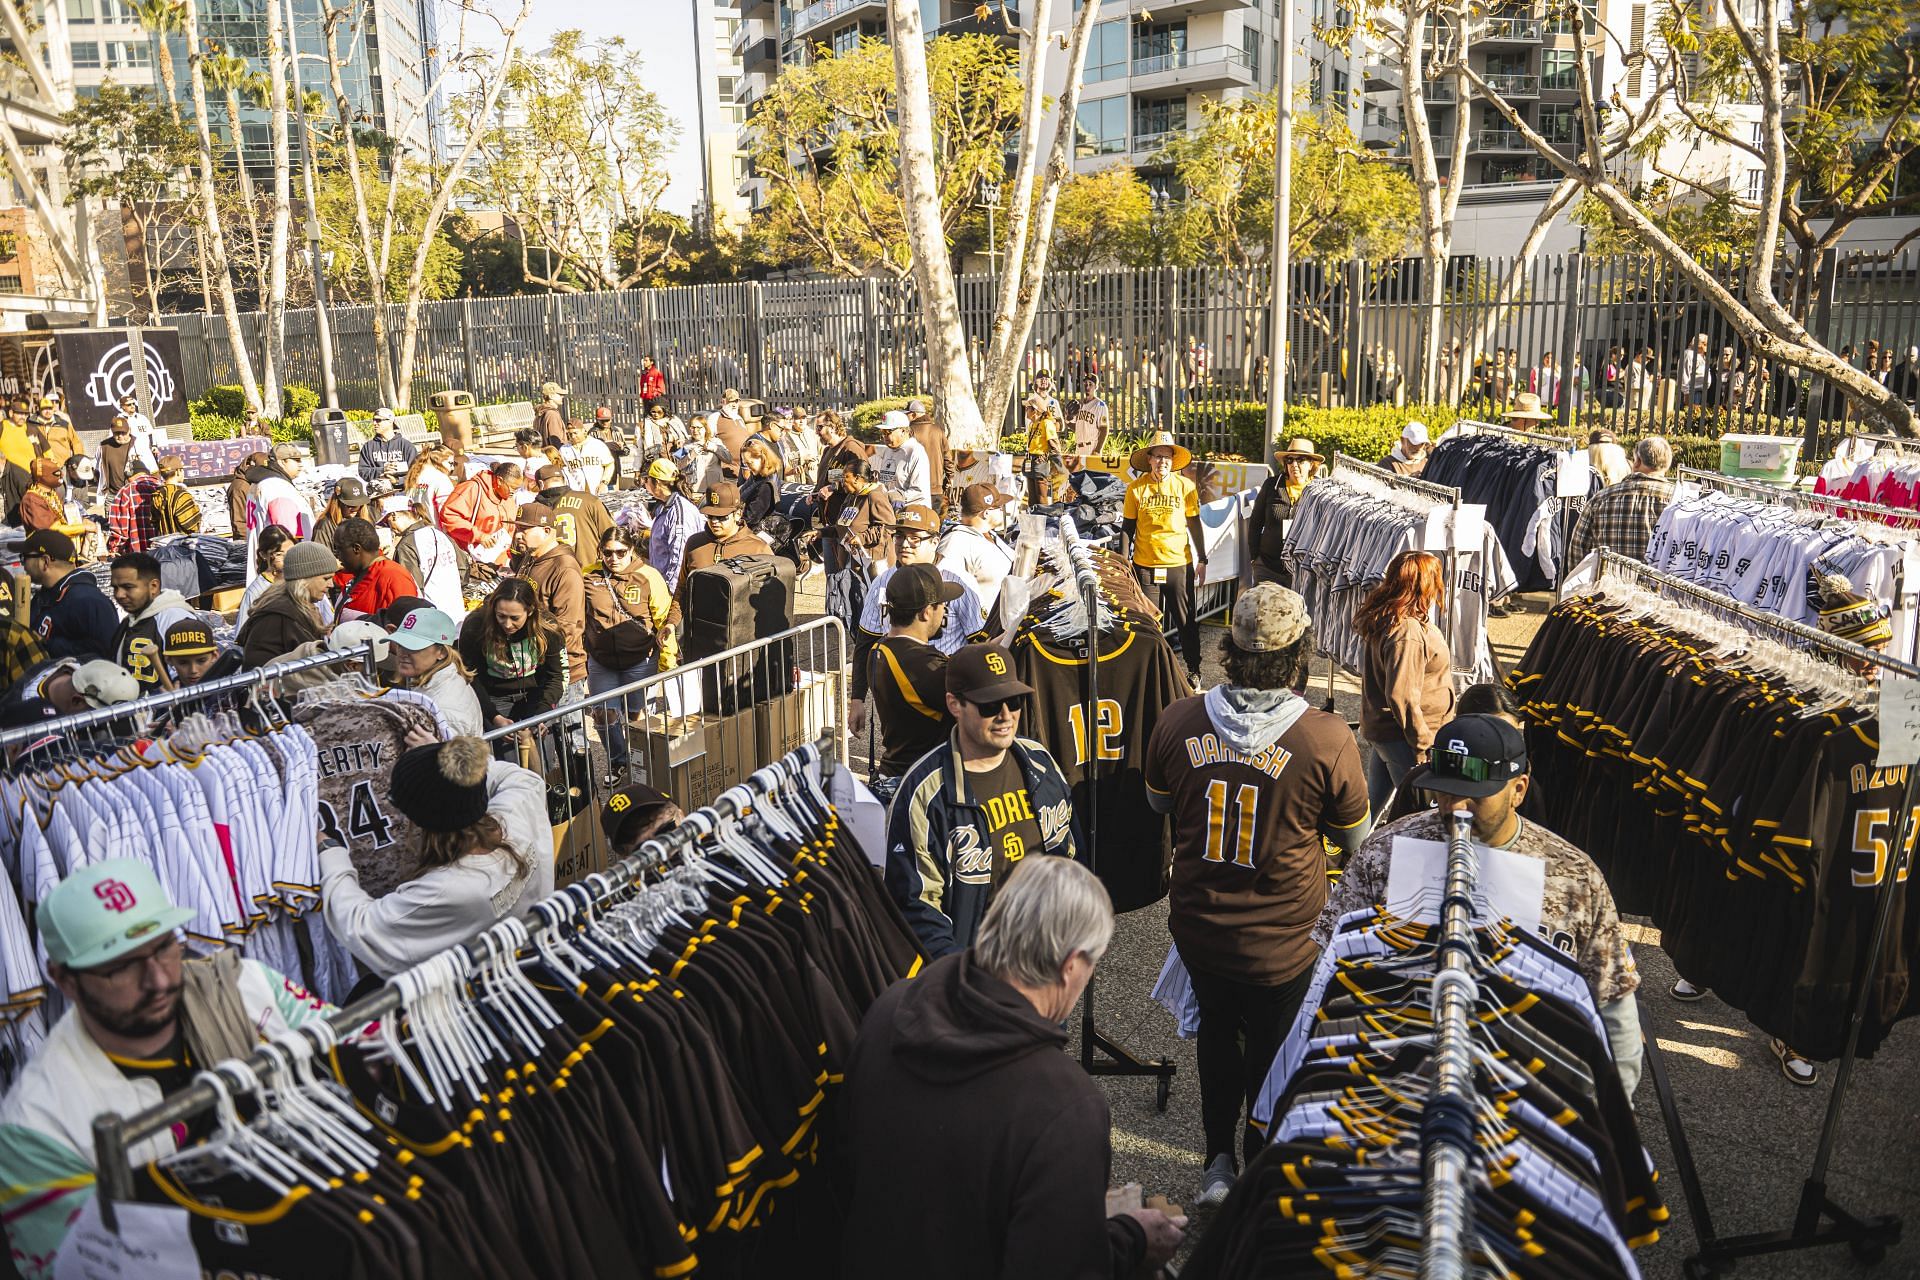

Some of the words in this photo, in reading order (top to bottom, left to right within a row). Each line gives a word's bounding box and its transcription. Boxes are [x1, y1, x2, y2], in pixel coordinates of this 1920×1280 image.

[372, 450, 403, 462] PADRES
[567, 456, 600, 471] PADRES
[557, 496, 583, 510] ADO
[1138, 494, 1181, 510] PADRES
[170, 631, 207, 646] PADRES
[985, 652, 1007, 675] SD
[1068, 698, 1124, 766] 12
[317, 742, 382, 780] ERTY
[609, 793, 632, 813] SD
[1202, 779, 1258, 870] 11
[1003, 832, 1025, 862] SD
[93, 878, 137, 914] SD
